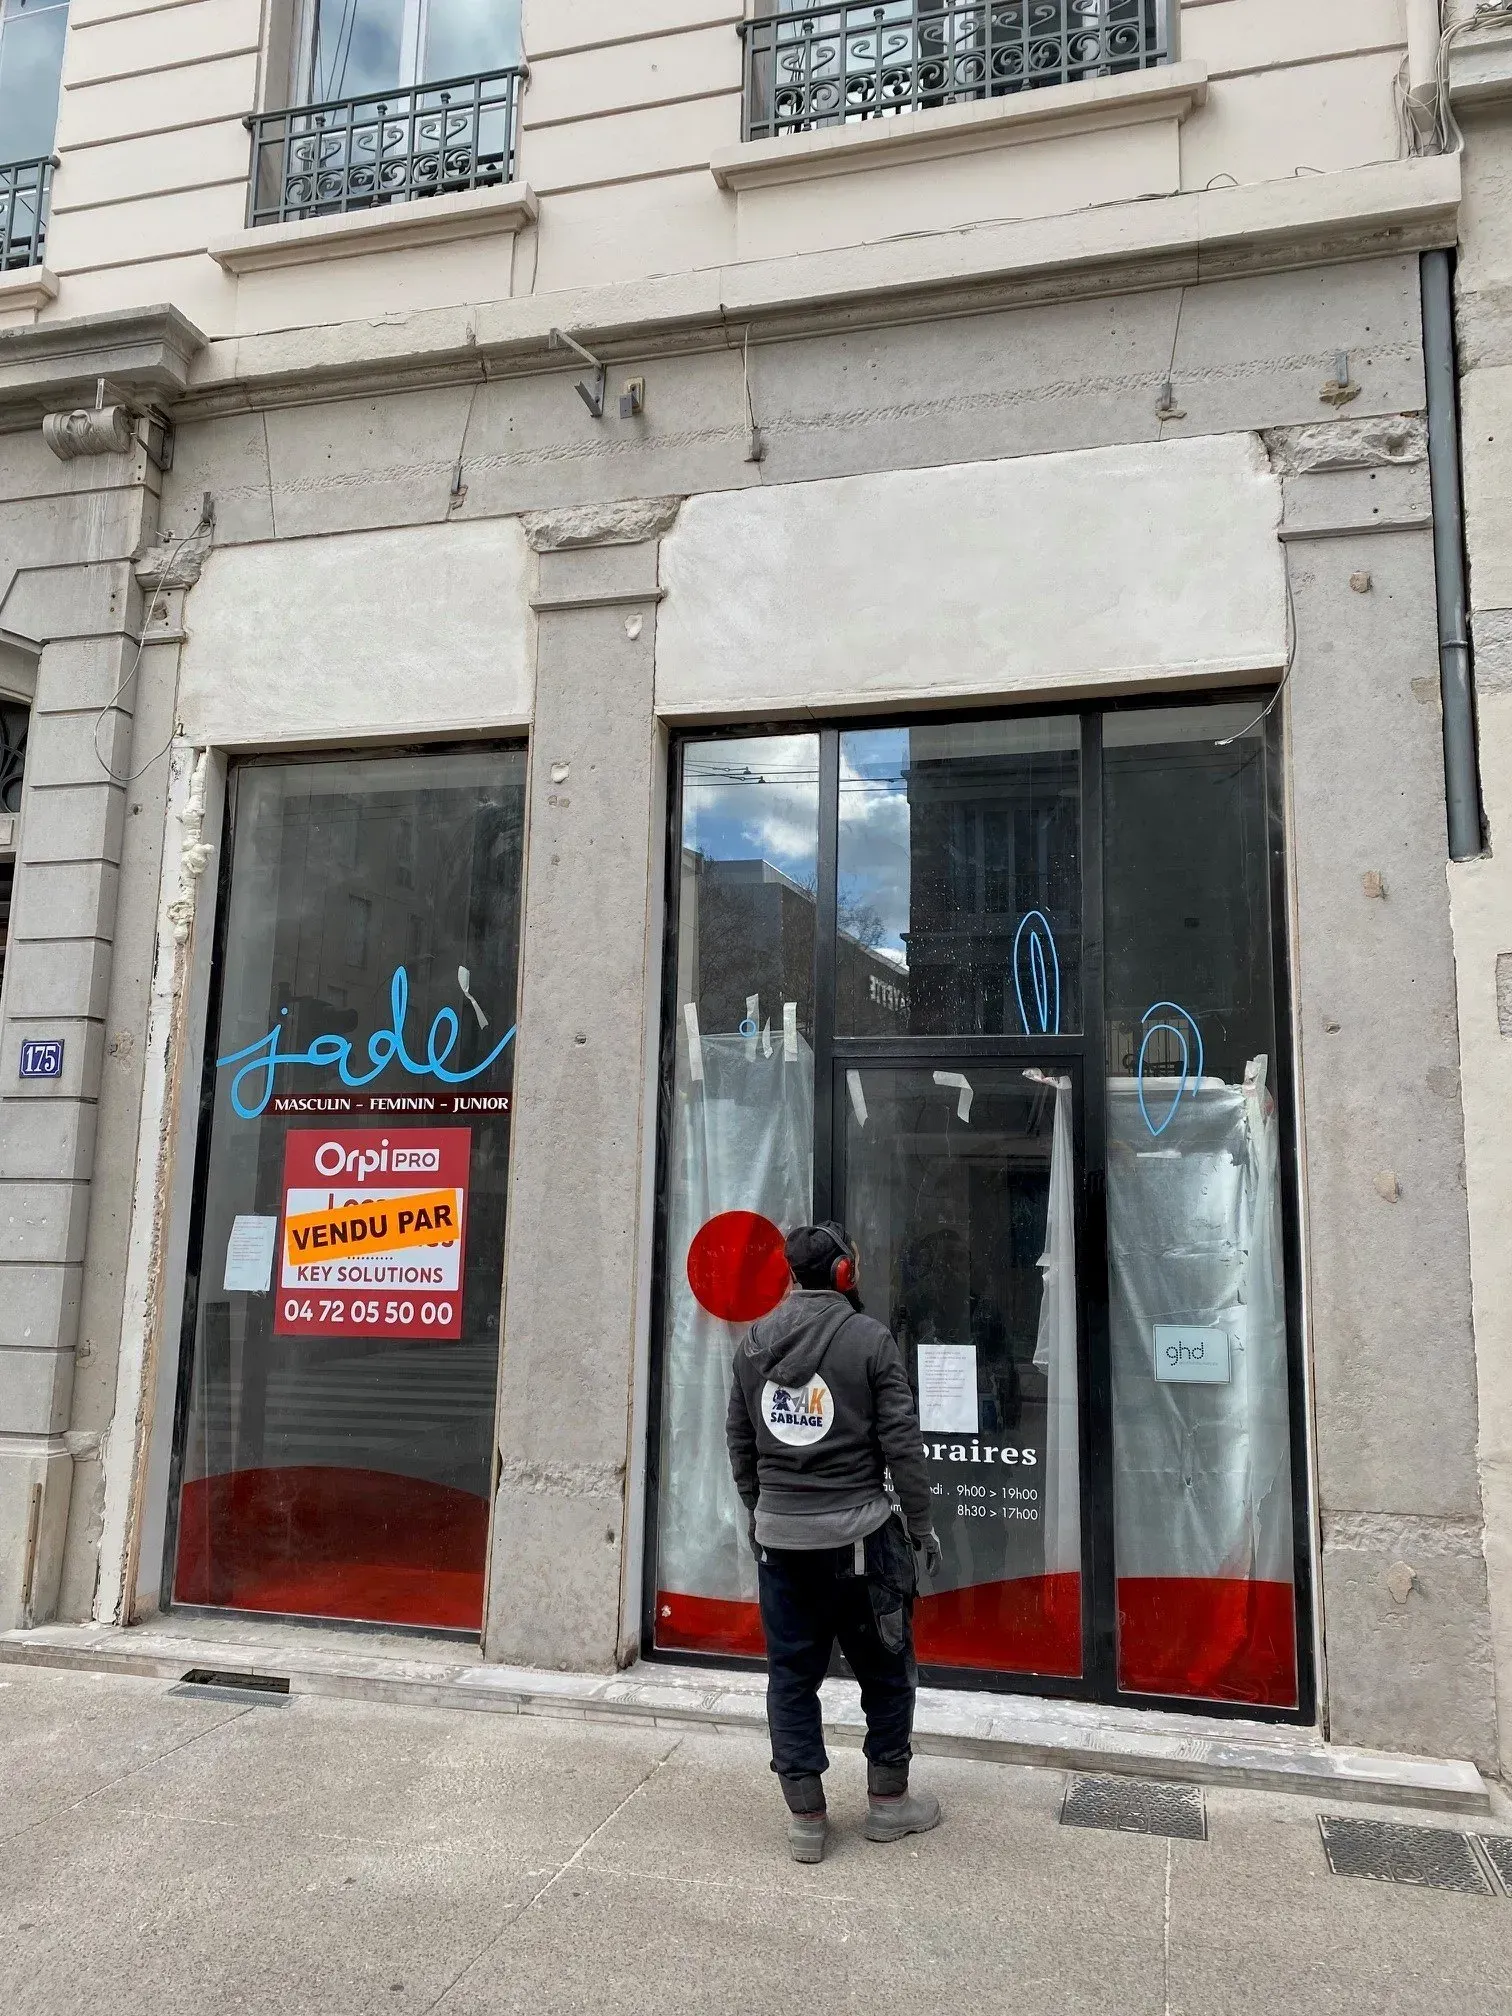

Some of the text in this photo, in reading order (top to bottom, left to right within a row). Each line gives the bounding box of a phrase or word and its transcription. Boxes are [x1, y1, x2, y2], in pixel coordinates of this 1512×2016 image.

[216, 966, 517, 1119] jade
[25, 1045, 56, 1072] 175
[274, 1098, 351, 1111] MASCULIN
[370, 1097, 435, 1110] FEMININ
[453, 1097, 509, 1112] JUNIOR
[314, 1138, 436, 1181] Orpi PRO
[292, 1214, 388, 1250] VENDU
[398, 1204, 453, 1234] PAR
[297, 1265, 443, 1283] KEY SOLUTIONS
[284, 1299, 453, 1324] 04 72 05 50 00
[1165, 1340, 1204, 1366] ghd
[770, 1412, 823, 1427] SABLAGE
[956, 1484, 986, 1497] 9h00
[1002, 1487, 1038, 1500] 19h00
[957, 1504, 986, 1517] 8h30
[1002, 1507, 1038, 1520] 17h00
